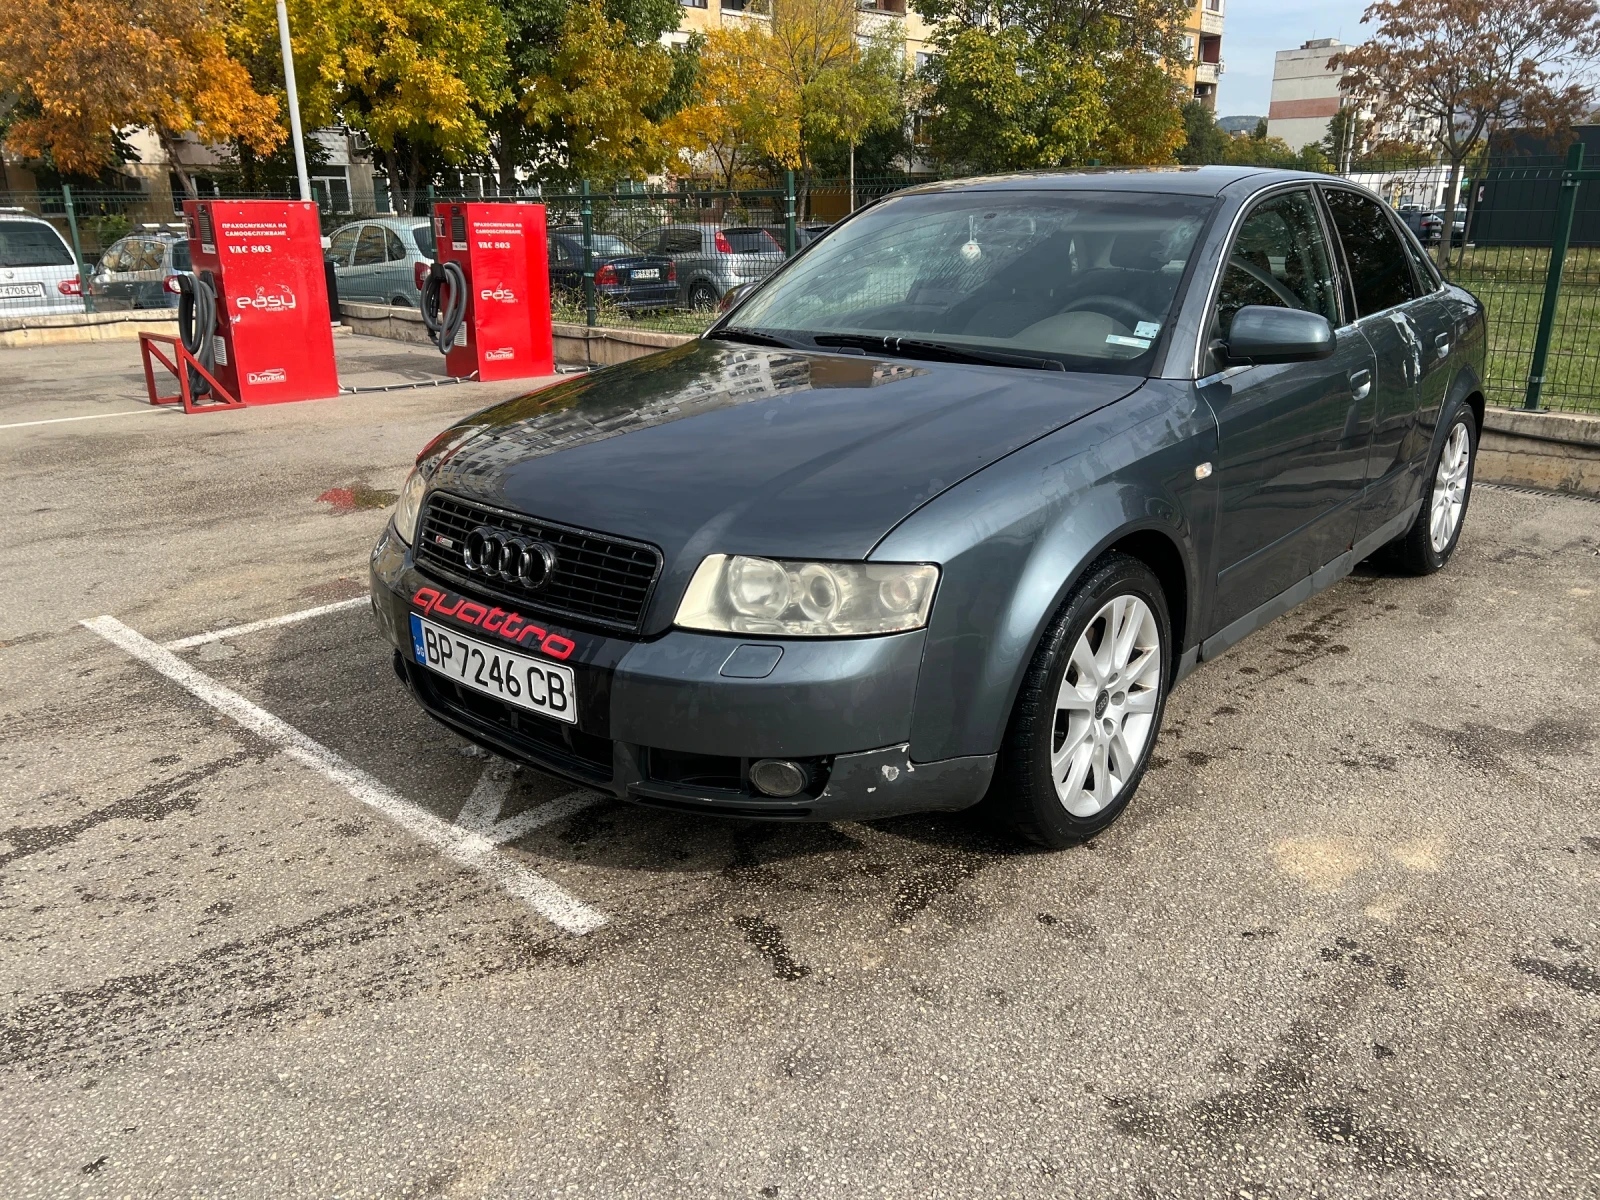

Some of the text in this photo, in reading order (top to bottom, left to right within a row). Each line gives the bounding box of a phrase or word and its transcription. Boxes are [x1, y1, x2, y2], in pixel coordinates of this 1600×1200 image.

[228, 245, 272, 254] VAC 803
[478, 241, 511, 249] VAC 803
[236, 294, 296, 309] easy
[413, 587, 576, 660] quattro
[416, 645, 425, 657] BG
[425, 627, 567, 712] BP 7246 CB
